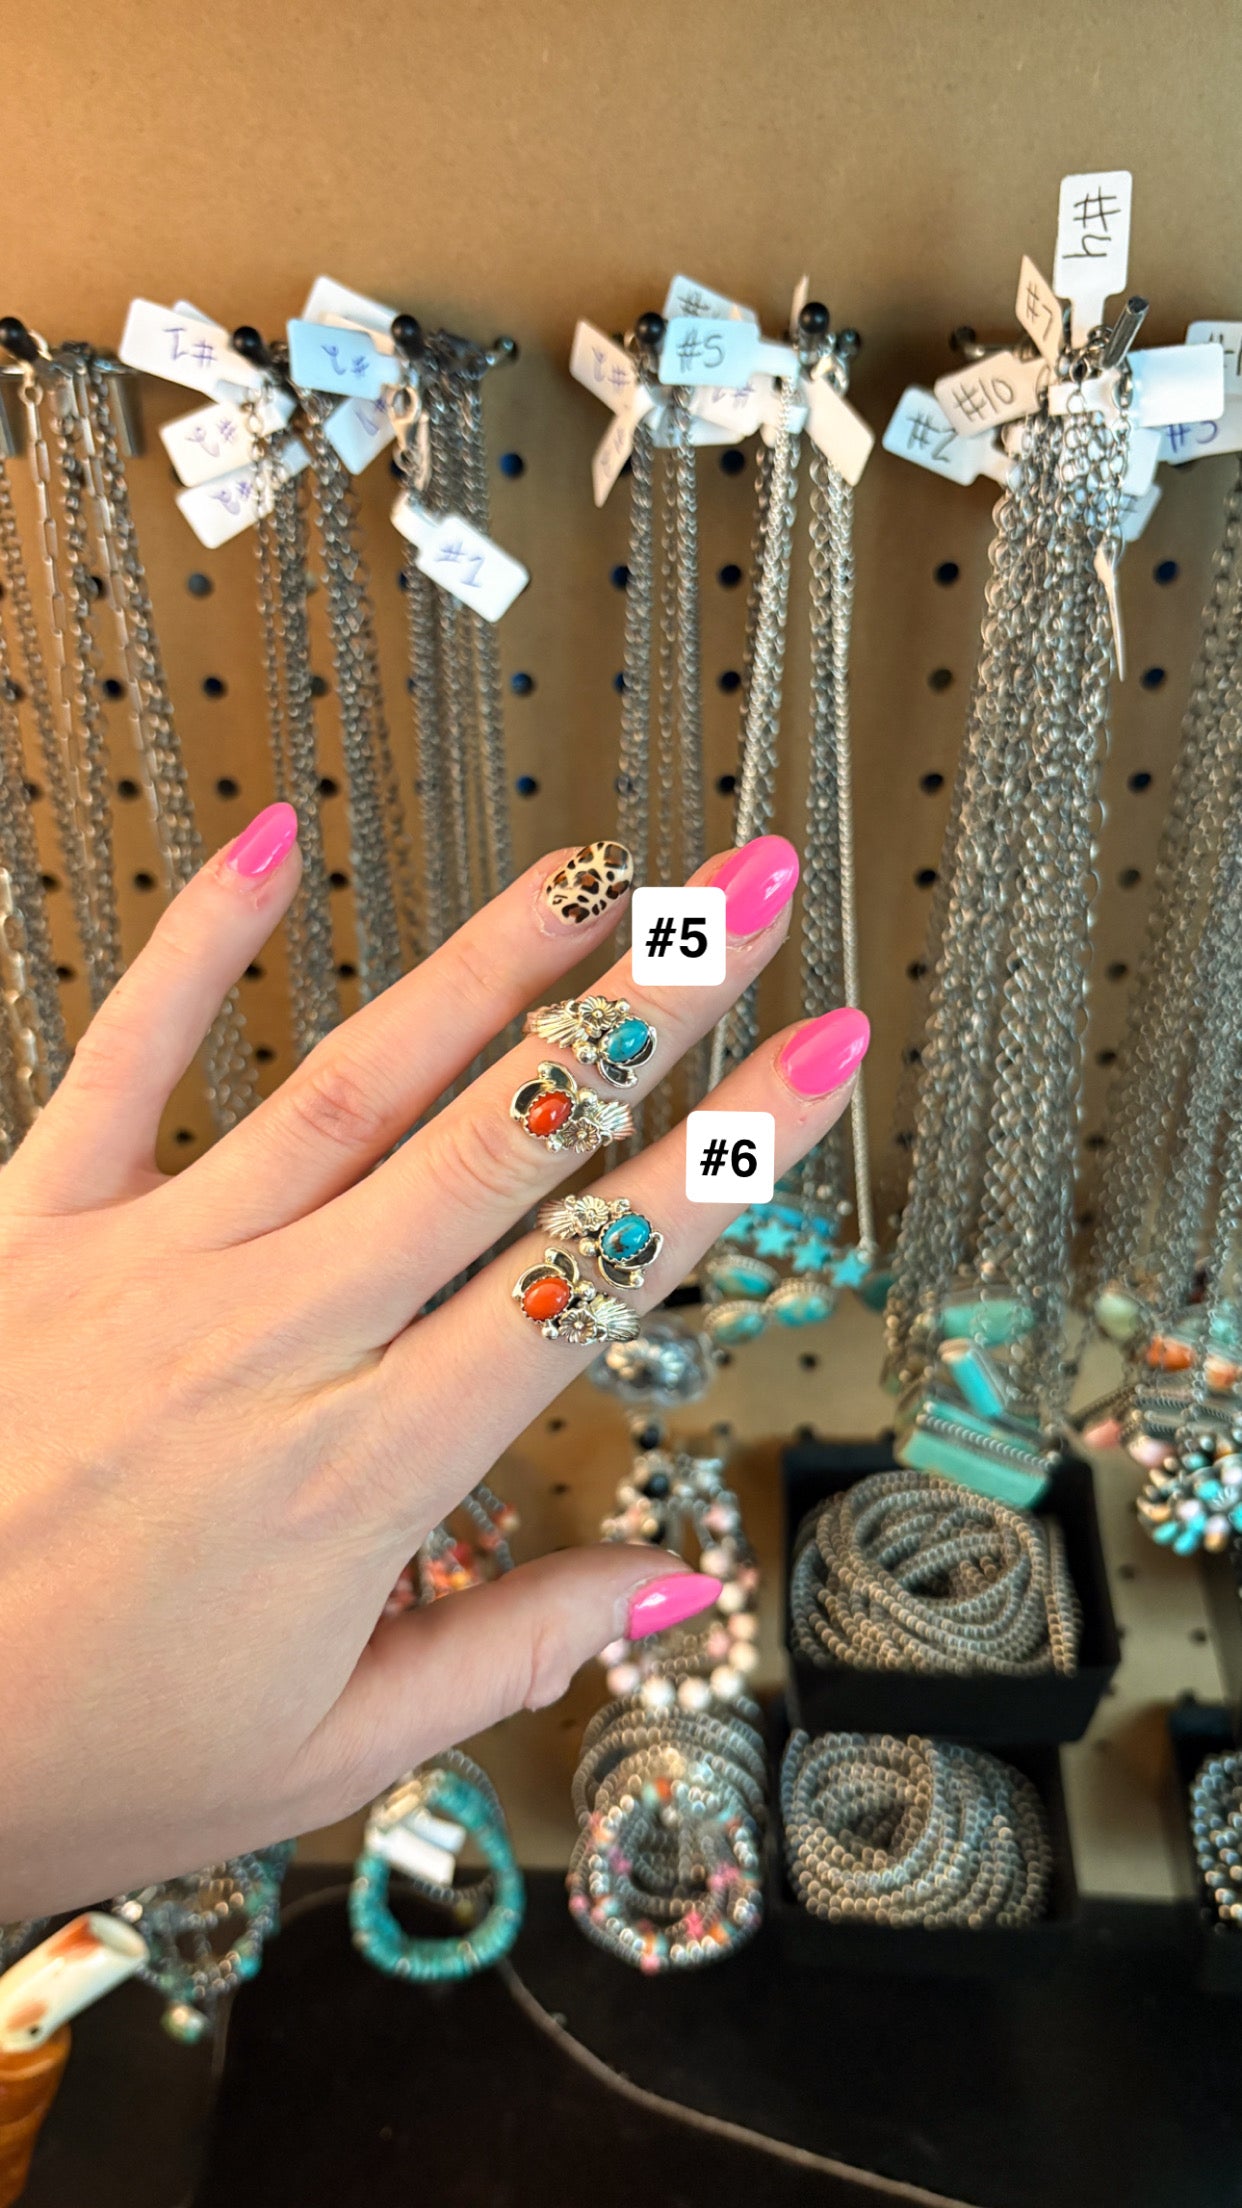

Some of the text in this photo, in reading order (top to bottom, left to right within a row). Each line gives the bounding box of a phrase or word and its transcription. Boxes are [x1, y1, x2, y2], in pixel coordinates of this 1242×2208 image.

[1062, 186, 1121, 259] #4
[162, 327, 218, 367] #1
[676, 329, 724, 374] #5
[952, 376, 1014, 423] #10
[432, 538, 487, 589] #1
